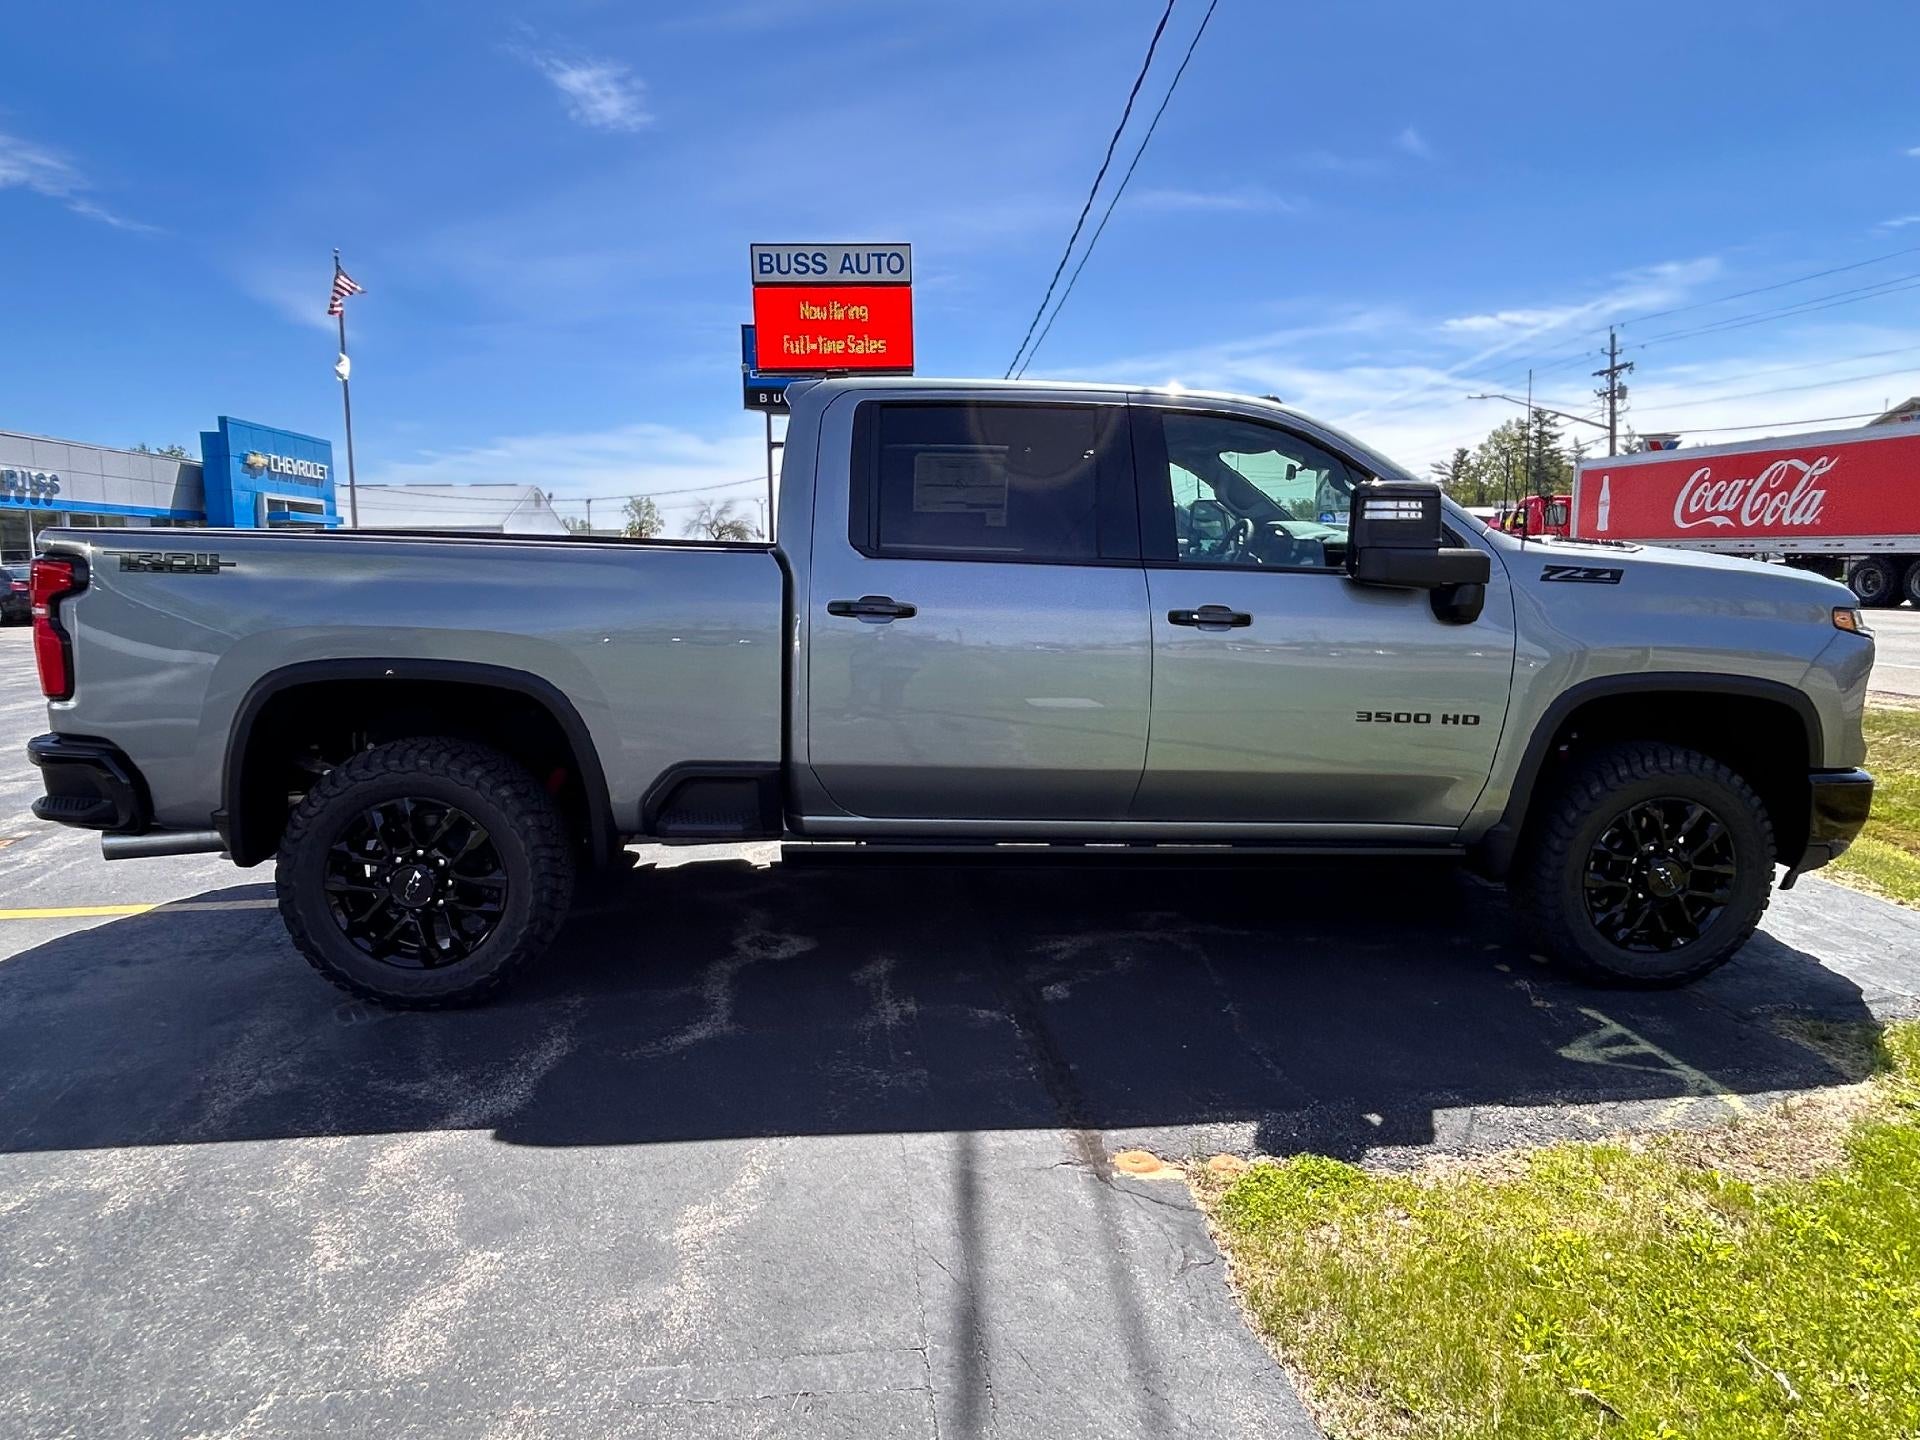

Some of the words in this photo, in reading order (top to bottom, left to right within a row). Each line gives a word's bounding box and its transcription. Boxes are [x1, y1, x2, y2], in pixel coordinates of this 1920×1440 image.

[759, 252, 828, 275] BUSS
[839, 252, 905, 275] AUTO
[799, 301, 827, 320] Now
[829, 301, 869, 322] Hiring
[847, 334, 887, 354] Sales
[759, 393, 781, 403] BU
[270, 454, 328, 480] CHEVROLET
[1673, 455, 1840, 529] Coca-Cola
[1355, 711, 1432, 724] 3500
[1441, 713, 1481, 726] HD
